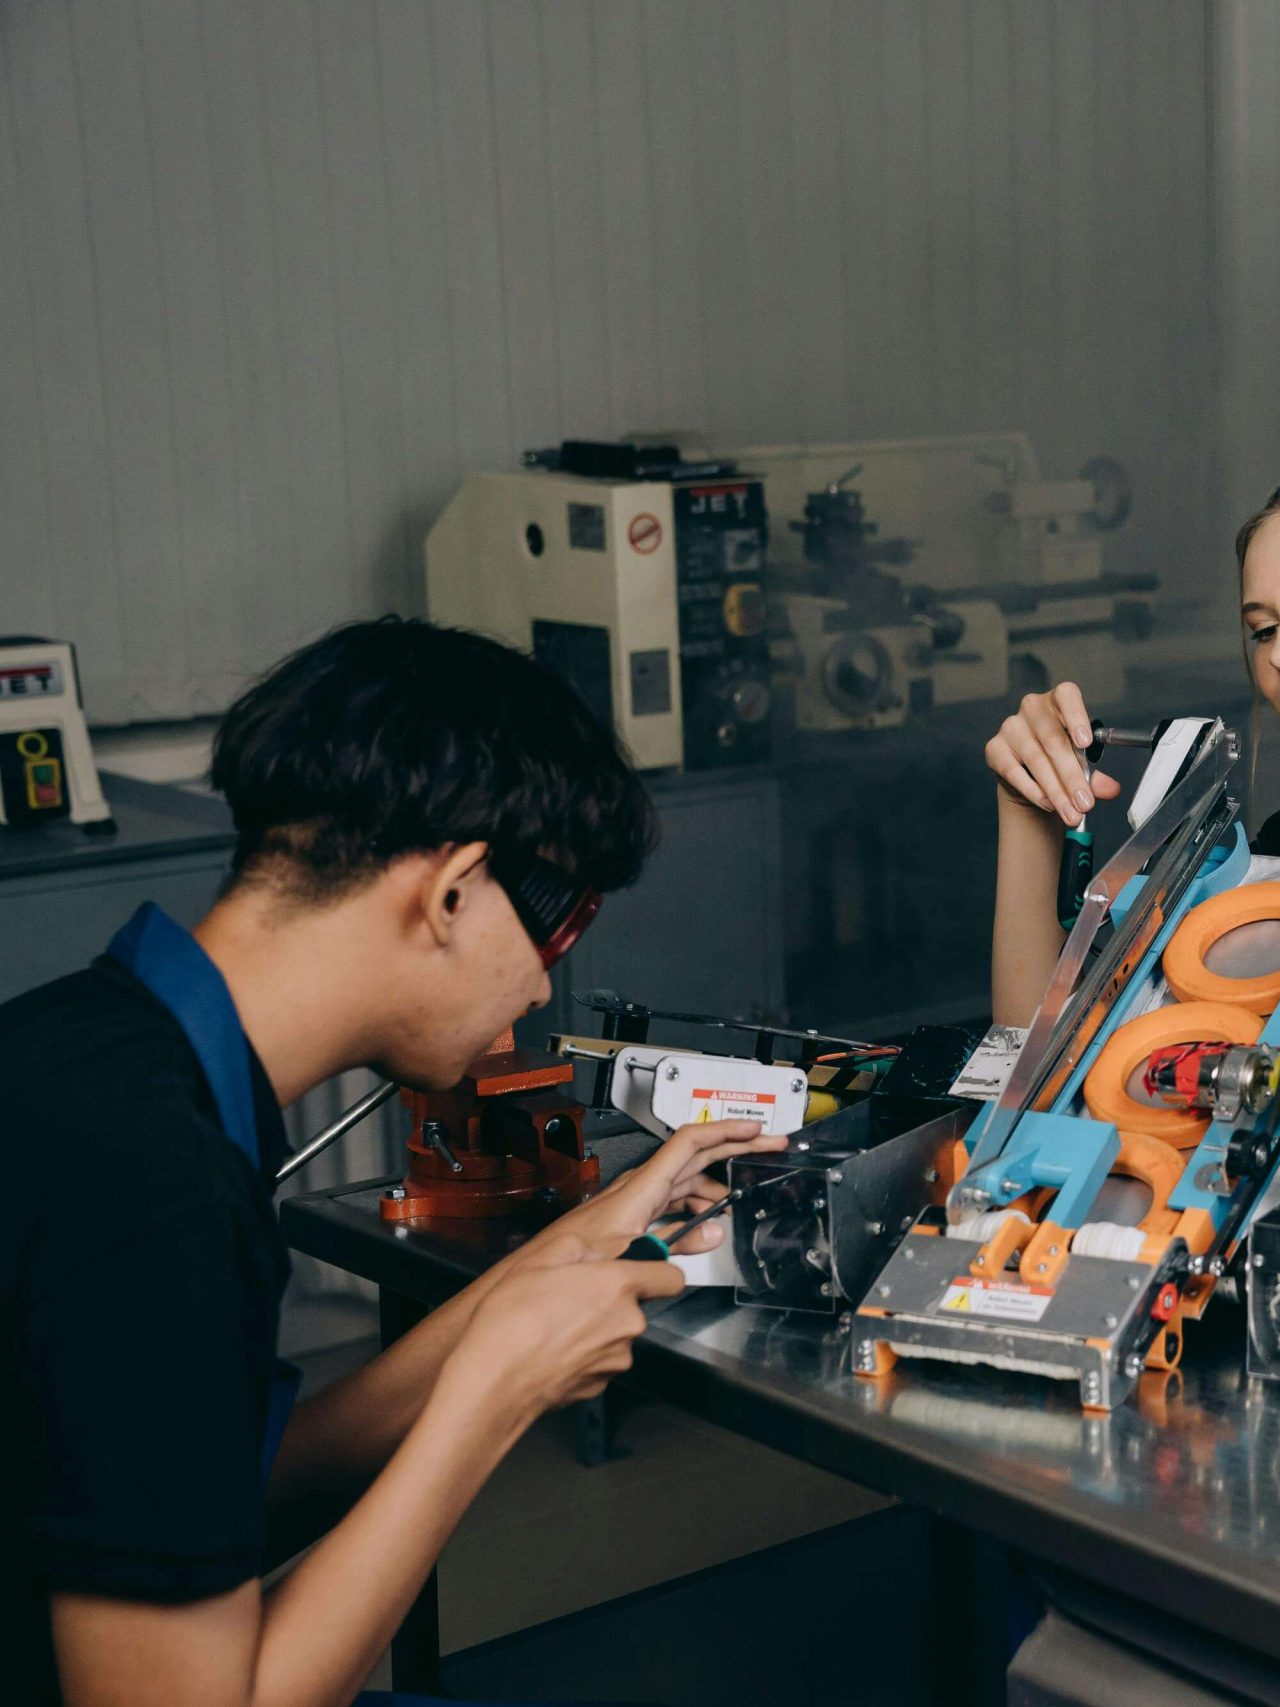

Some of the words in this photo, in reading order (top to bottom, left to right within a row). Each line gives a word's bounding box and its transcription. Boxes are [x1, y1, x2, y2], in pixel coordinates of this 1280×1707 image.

[689, 492, 748, 518] JET
[0, 673, 51, 695] ET
[719, 1091, 758, 1102] WARNING
[728, 1107, 745, 1115] Robot
[746, 1108, 765, 1117] Moves
